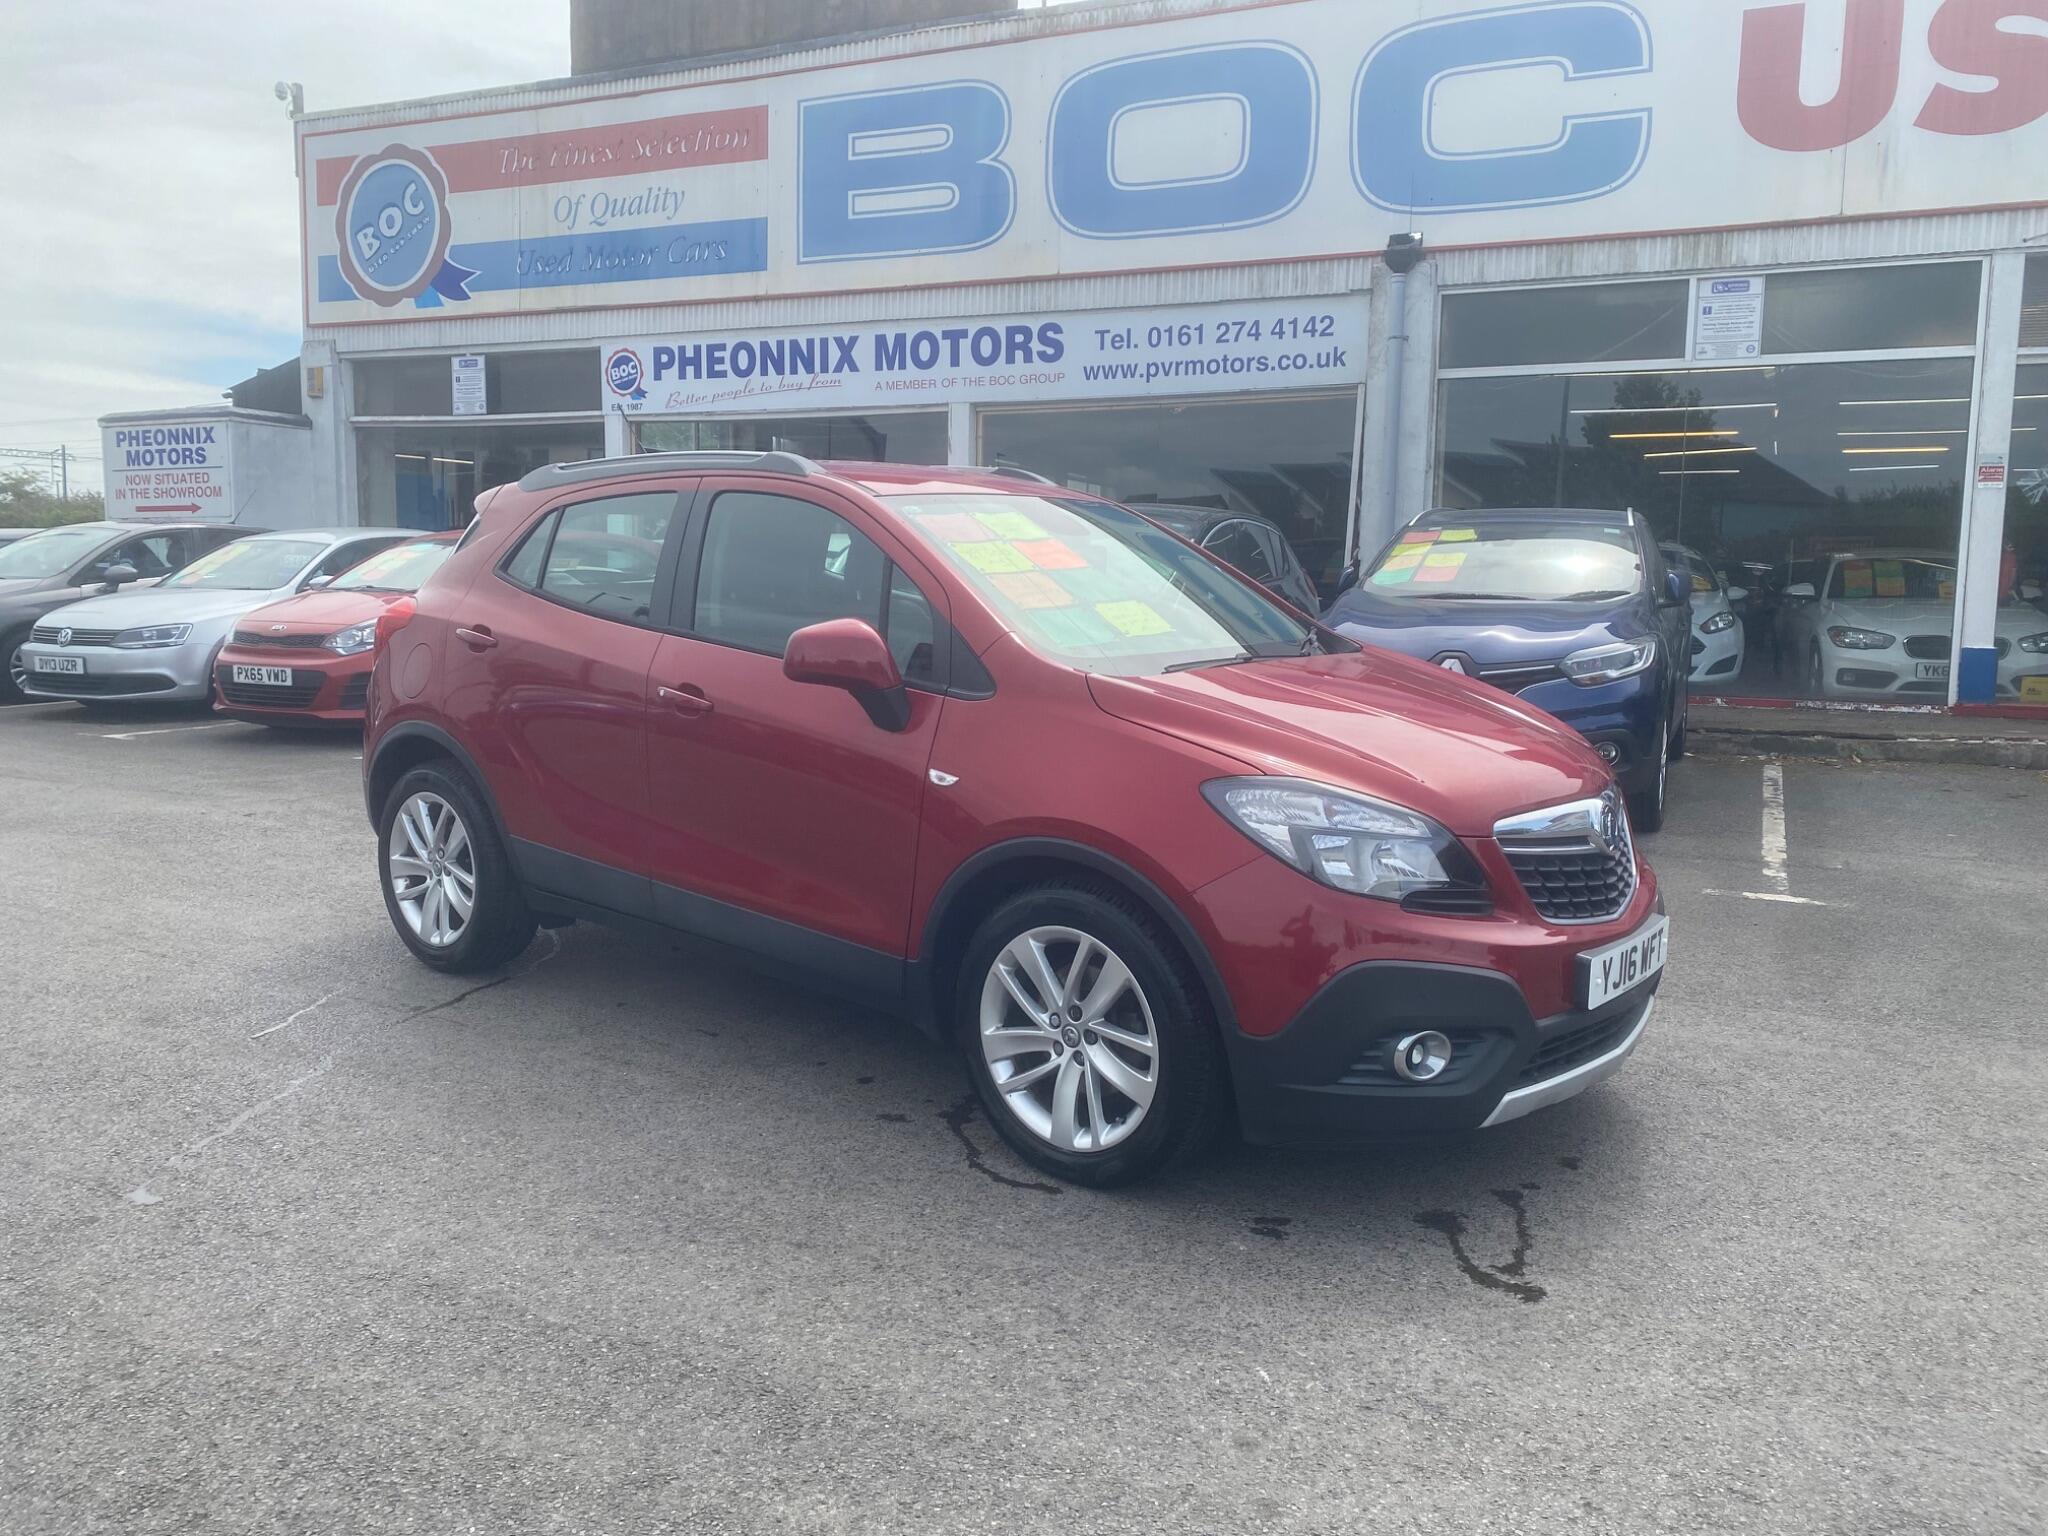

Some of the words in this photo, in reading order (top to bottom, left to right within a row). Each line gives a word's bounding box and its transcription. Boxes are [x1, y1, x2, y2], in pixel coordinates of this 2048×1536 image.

[501, 148, 541, 174] The
[550, 138, 624, 168] Finest
[632, 125, 751, 160] Selection
[798, 1, 1652, 265] BOC
[356, 181, 425, 261] BOC
[553, 194, 583, 230] Of
[589, 186, 686, 227] Quality
[516, 246, 575, 276] Used
[580, 244, 660, 273] Motor
[667, 235, 729, 265] Cars
[1094, 328, 1139, 351] Tel.
[1147, 323, 1206, 348] 0161
[1215, 319, 1262, 344] 274
[1270, 315, 1335, 340] 4142
[652, 335, 860, 381] PHEONNIX
[874, 322, 1065, 371] MOTORS
[1083, 346, 1347, 383] www.pvrmotors.co.uk
[611, 361, 637, 381] BOC
[875, 381, 883, 391] A
[886, 379, 937, 391] MEMBER
[941, 377, 958, 388] OF
[961, 376, 985, 387] THE
[989, 375, 1016, 386] BOC
[1019, 372, 1066, 385] GROUP
[627, 402, 643, 411] 1987
[665, 391, 707, 408] Better
[712, 377, 754, 404] people
[760, 379, 772, 392] to
[777, 376, 803, 392] buy
[808, 372, 842, 391] from
[115, 426, 216, 448] PHEONNIX
[126, 446, 207, 467] MOTORS
[115, 489, 126, 500] IN
[129, 488, 150, 499] THE
[153, 486, 222, 499] SHOWROOM
[125, 474, 151, 486] NOW
[154, 472, 210, 485] SITUATED
[237, 666, 264, 681] PX65
[265, 668, 288, 683] VWD
[1602, 944, 1638, 995] YJ16
